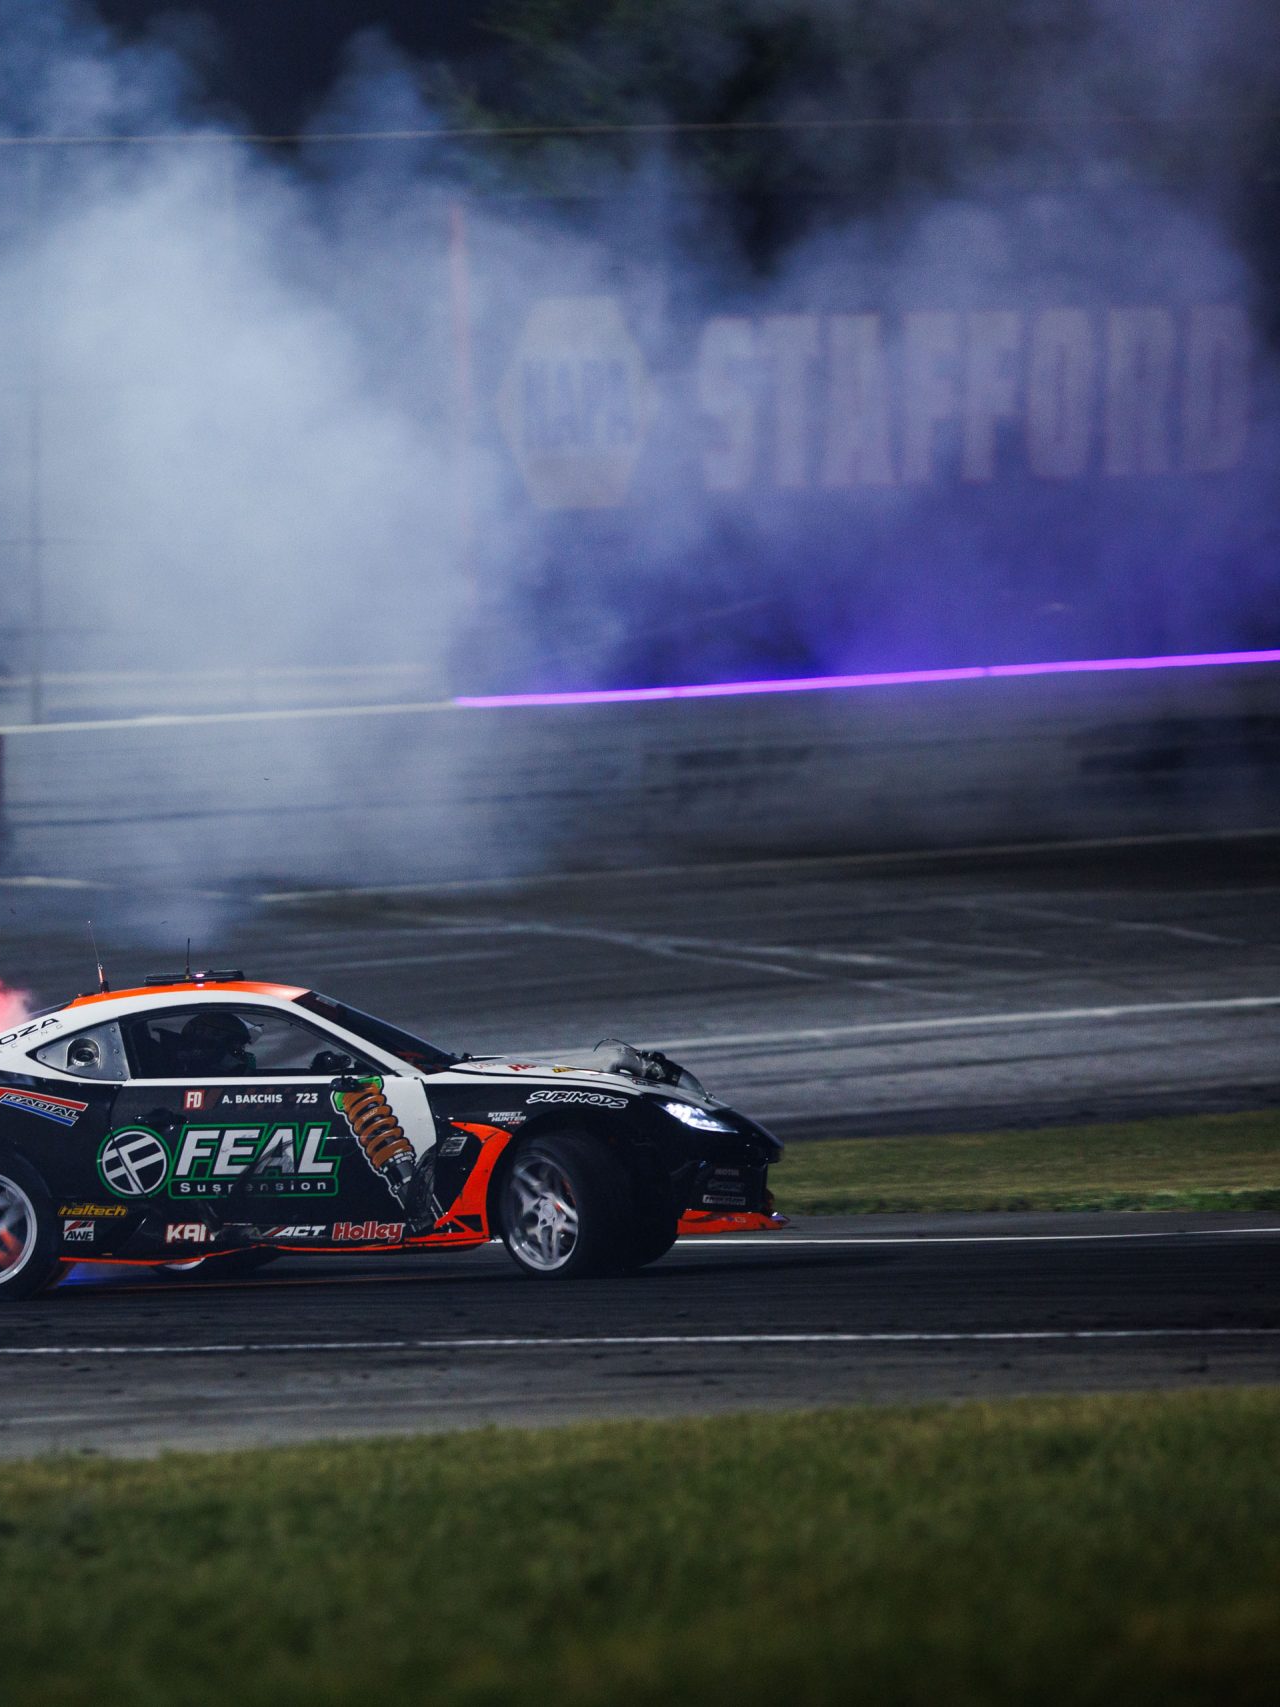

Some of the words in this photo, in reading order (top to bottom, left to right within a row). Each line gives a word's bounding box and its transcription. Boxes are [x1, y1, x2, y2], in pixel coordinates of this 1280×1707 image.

[699, 306, 1252, 490] STAFFORD
[3, 1093, 80, 1121] RADIAL
[186, 1091, 203, 1109] FD
[222, 1095, 233, 1104] A.
[235, 1094, 283, 1104] BAKCHIS
[296, 1093, 319, 1104] 723
[526, 1090, 629, 1109] SUBIMODS
[175, 1128, 335, 1176] FEAL
[65, 1230, 93, 1241] AWE
[274, 1225, 326, 1237] ACT
[332, 1221, 405, 1243] Holley
